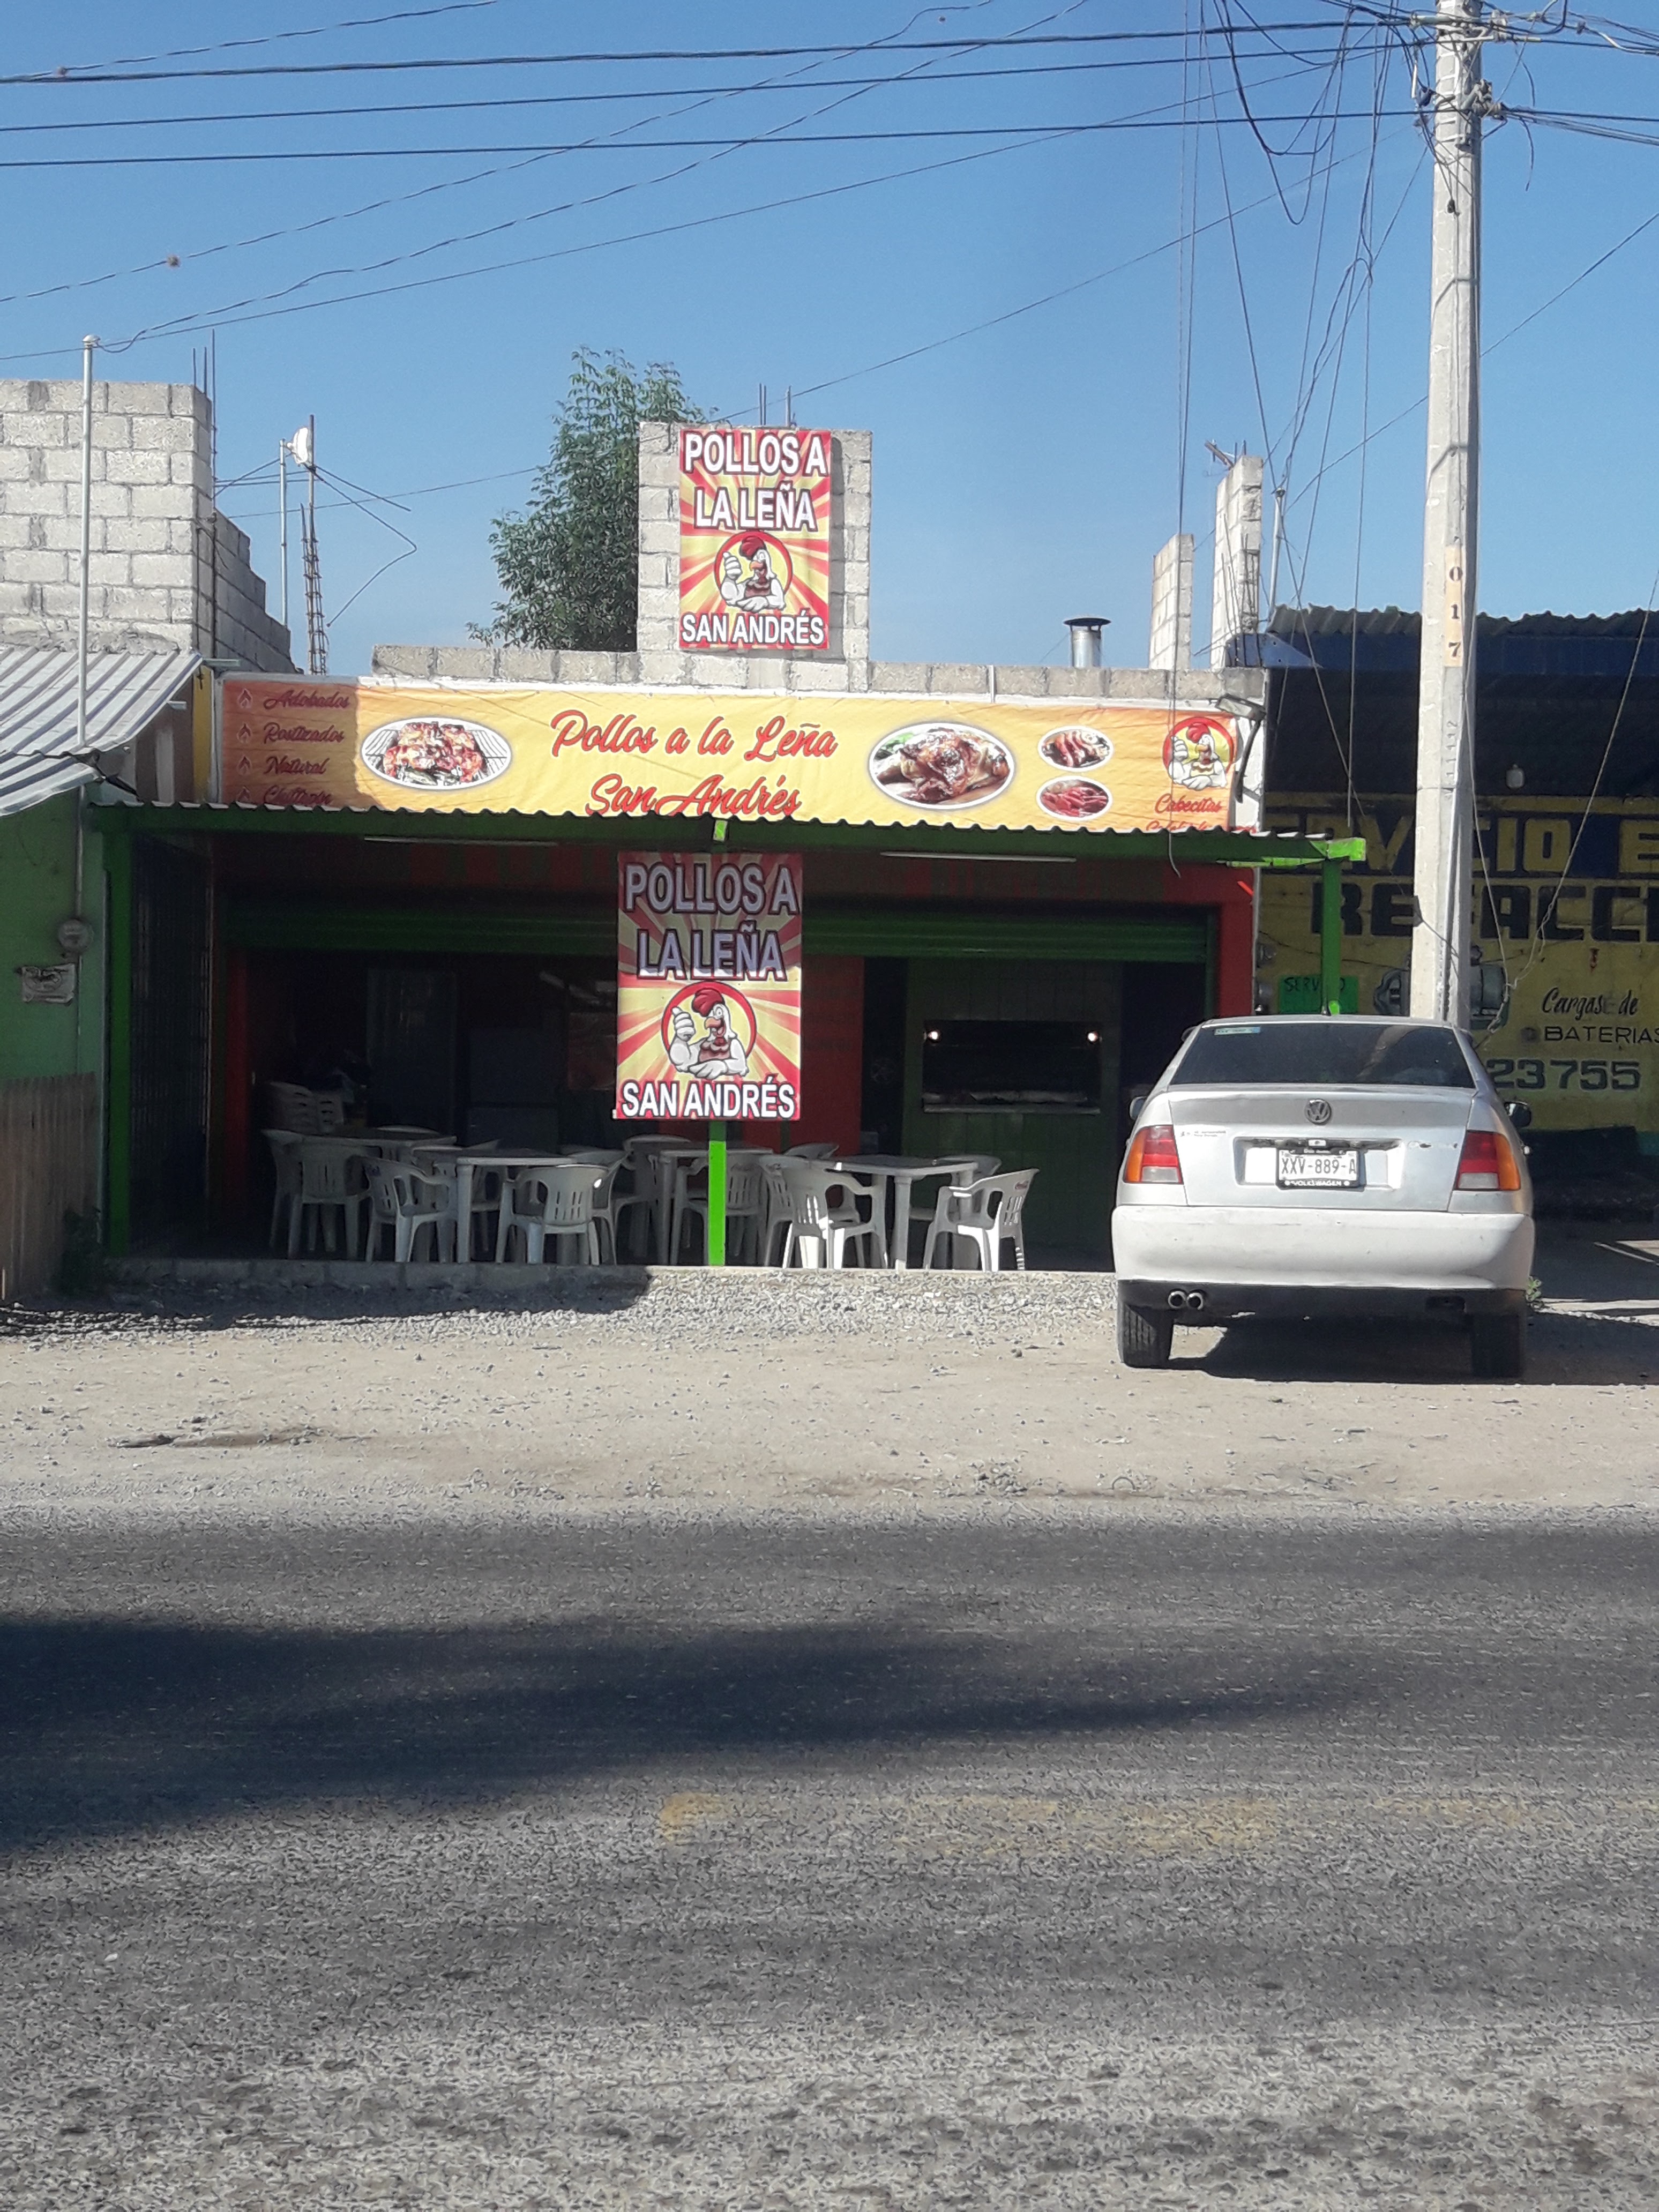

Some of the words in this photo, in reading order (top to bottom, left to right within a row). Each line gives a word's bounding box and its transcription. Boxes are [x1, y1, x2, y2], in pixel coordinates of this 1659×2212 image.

[685, 432, 799, 475] POLLOS
[803, 435, 828, 475] A
[694, 487, 735, 529] LA
[739, 481, 817, 531] LEÑA
[682, 614, 728, 644] SAN
[731, 608, 825, 645] ANDRÉS
[263, 690, 350, 710] Adobados
[550, 711, 657, 757] Pollos
[666, 723, 690, 754] a
[698, 716, 734, 756] la
[744, 716, 838, 763] Leña
[264, 756, 330, 775] Natural
[585, 773, 657, 816] San
[654, 774, 802, 817] Andrés
[1155, 793, 1222, 813] Cabecitas
[625, 862, 765, 914] POLLOS
[769, 866, 799, 915] A
[637, 929, 687, 980] LA
[691, 920, 787, 981] LEÑA
[1542, 987, 1603, 1020] Cargas
[1618, 990, 1639, 1015] de
[622, 1080, 678, 1118] SAN
[683, 1073, 795, 1119] ANDRÉS
[1281, 1157, 1356, 1175] XXV-889-A
